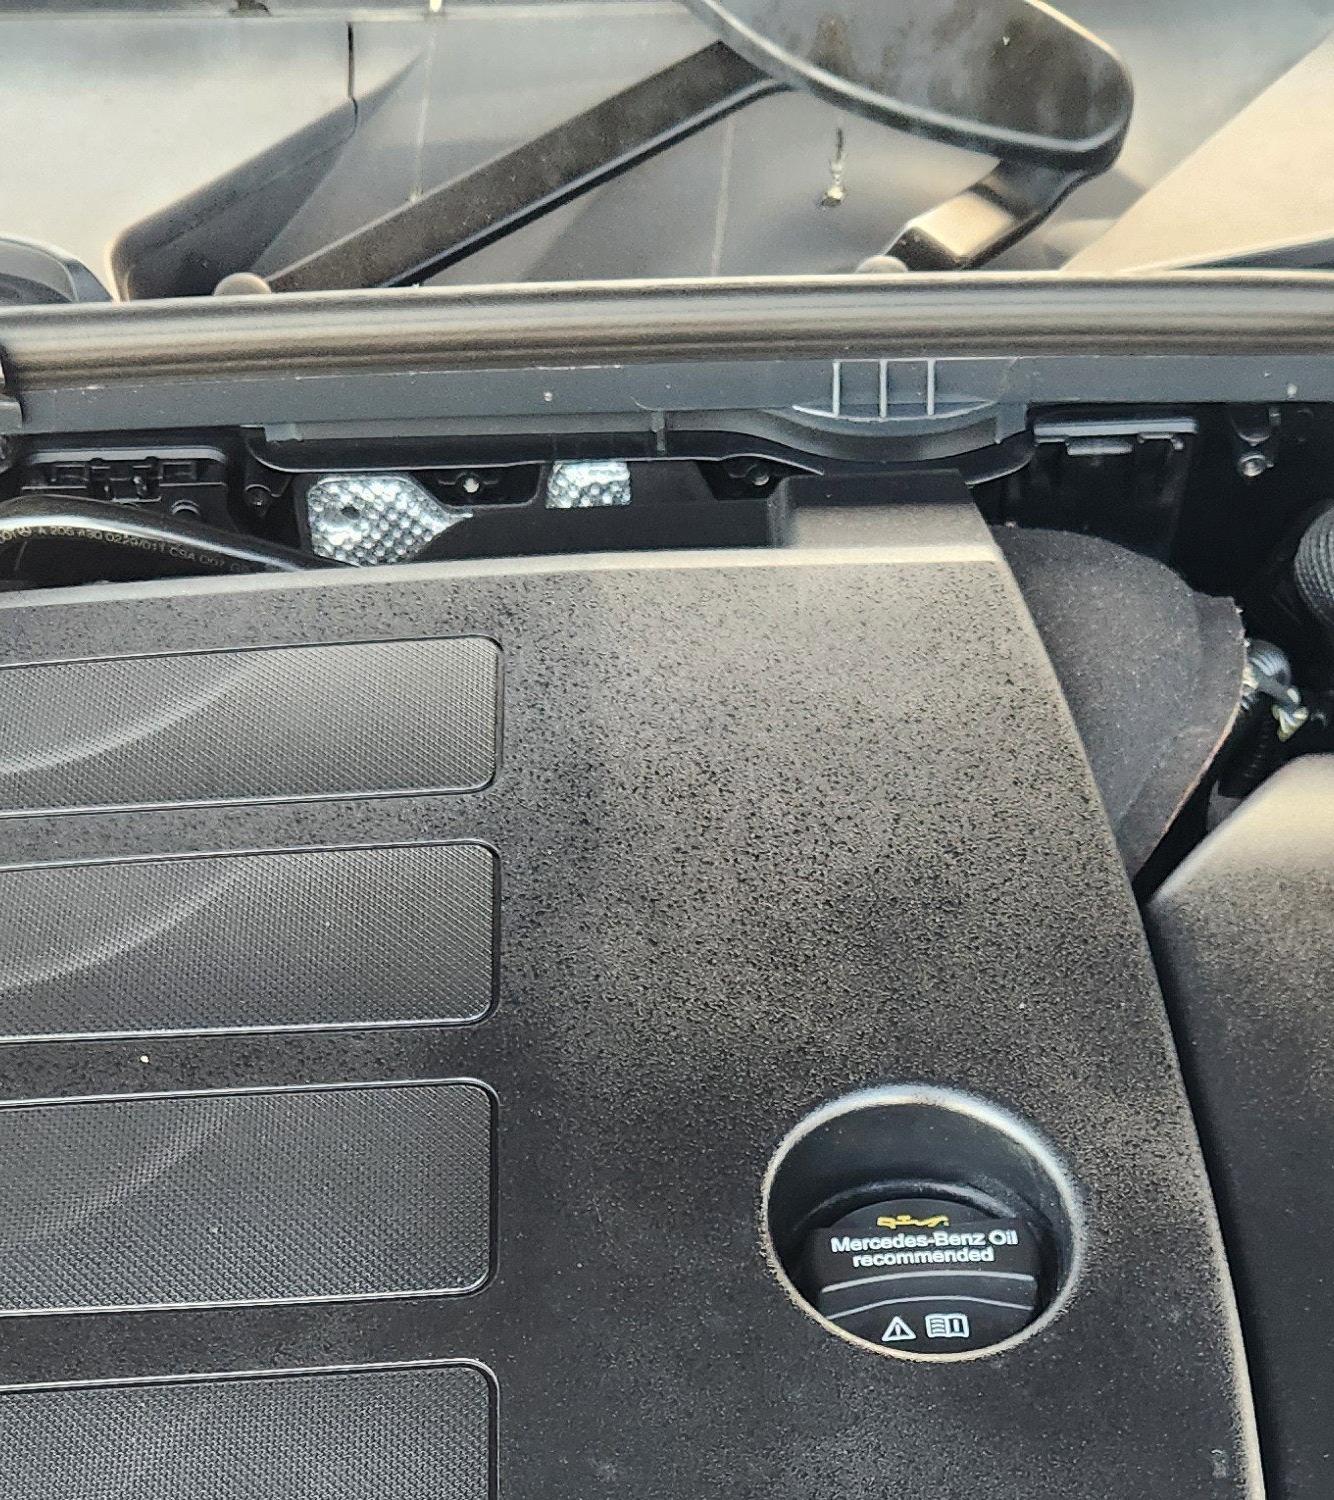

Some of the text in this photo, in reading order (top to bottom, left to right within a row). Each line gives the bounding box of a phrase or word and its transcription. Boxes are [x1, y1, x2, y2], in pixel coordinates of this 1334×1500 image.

[831, 1229, 1018, 1253] Mercedes-Benz Oil
[853, 1246, 995, 1268] recommended
